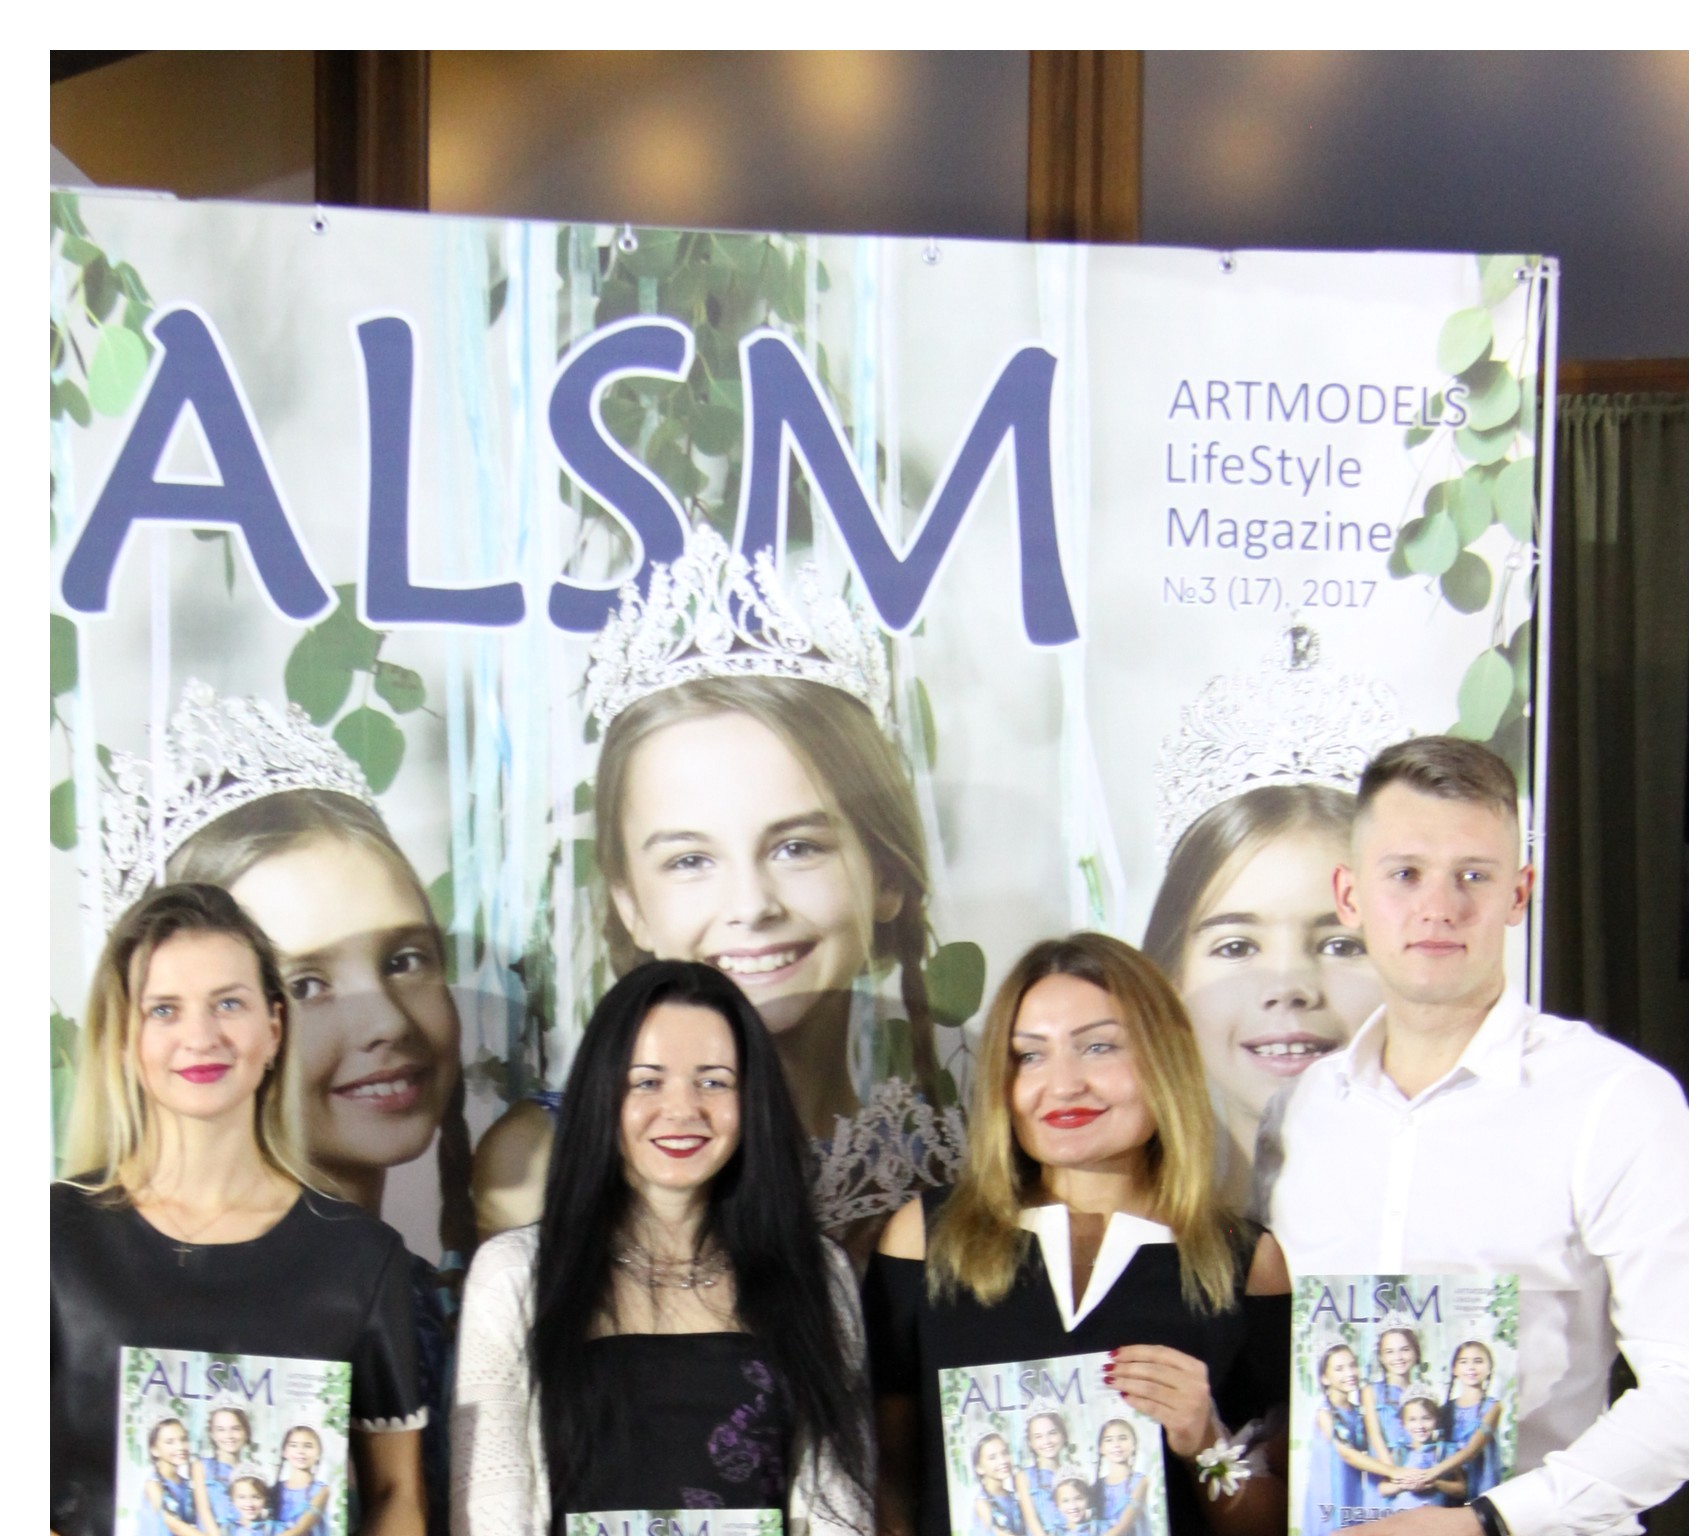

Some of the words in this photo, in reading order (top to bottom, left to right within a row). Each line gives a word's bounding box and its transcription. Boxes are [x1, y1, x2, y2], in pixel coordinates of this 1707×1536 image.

[1168, 378, 1470, 428] ARTMODELS
[58, 300, 1082, 650] ALSM
[1166, 440, 1362, 497] LifeStyle
[1167, 507, 1392, 560] Magazine
[1163, 576, 1217, 605] №3
[1302, 579, 1378, 607] 2017
[1310, 1283, 1443, 1324] ALSM
[140, 1358, 276, 1407] ALSM
[959, 1367, 1087, 1416] ALSM
